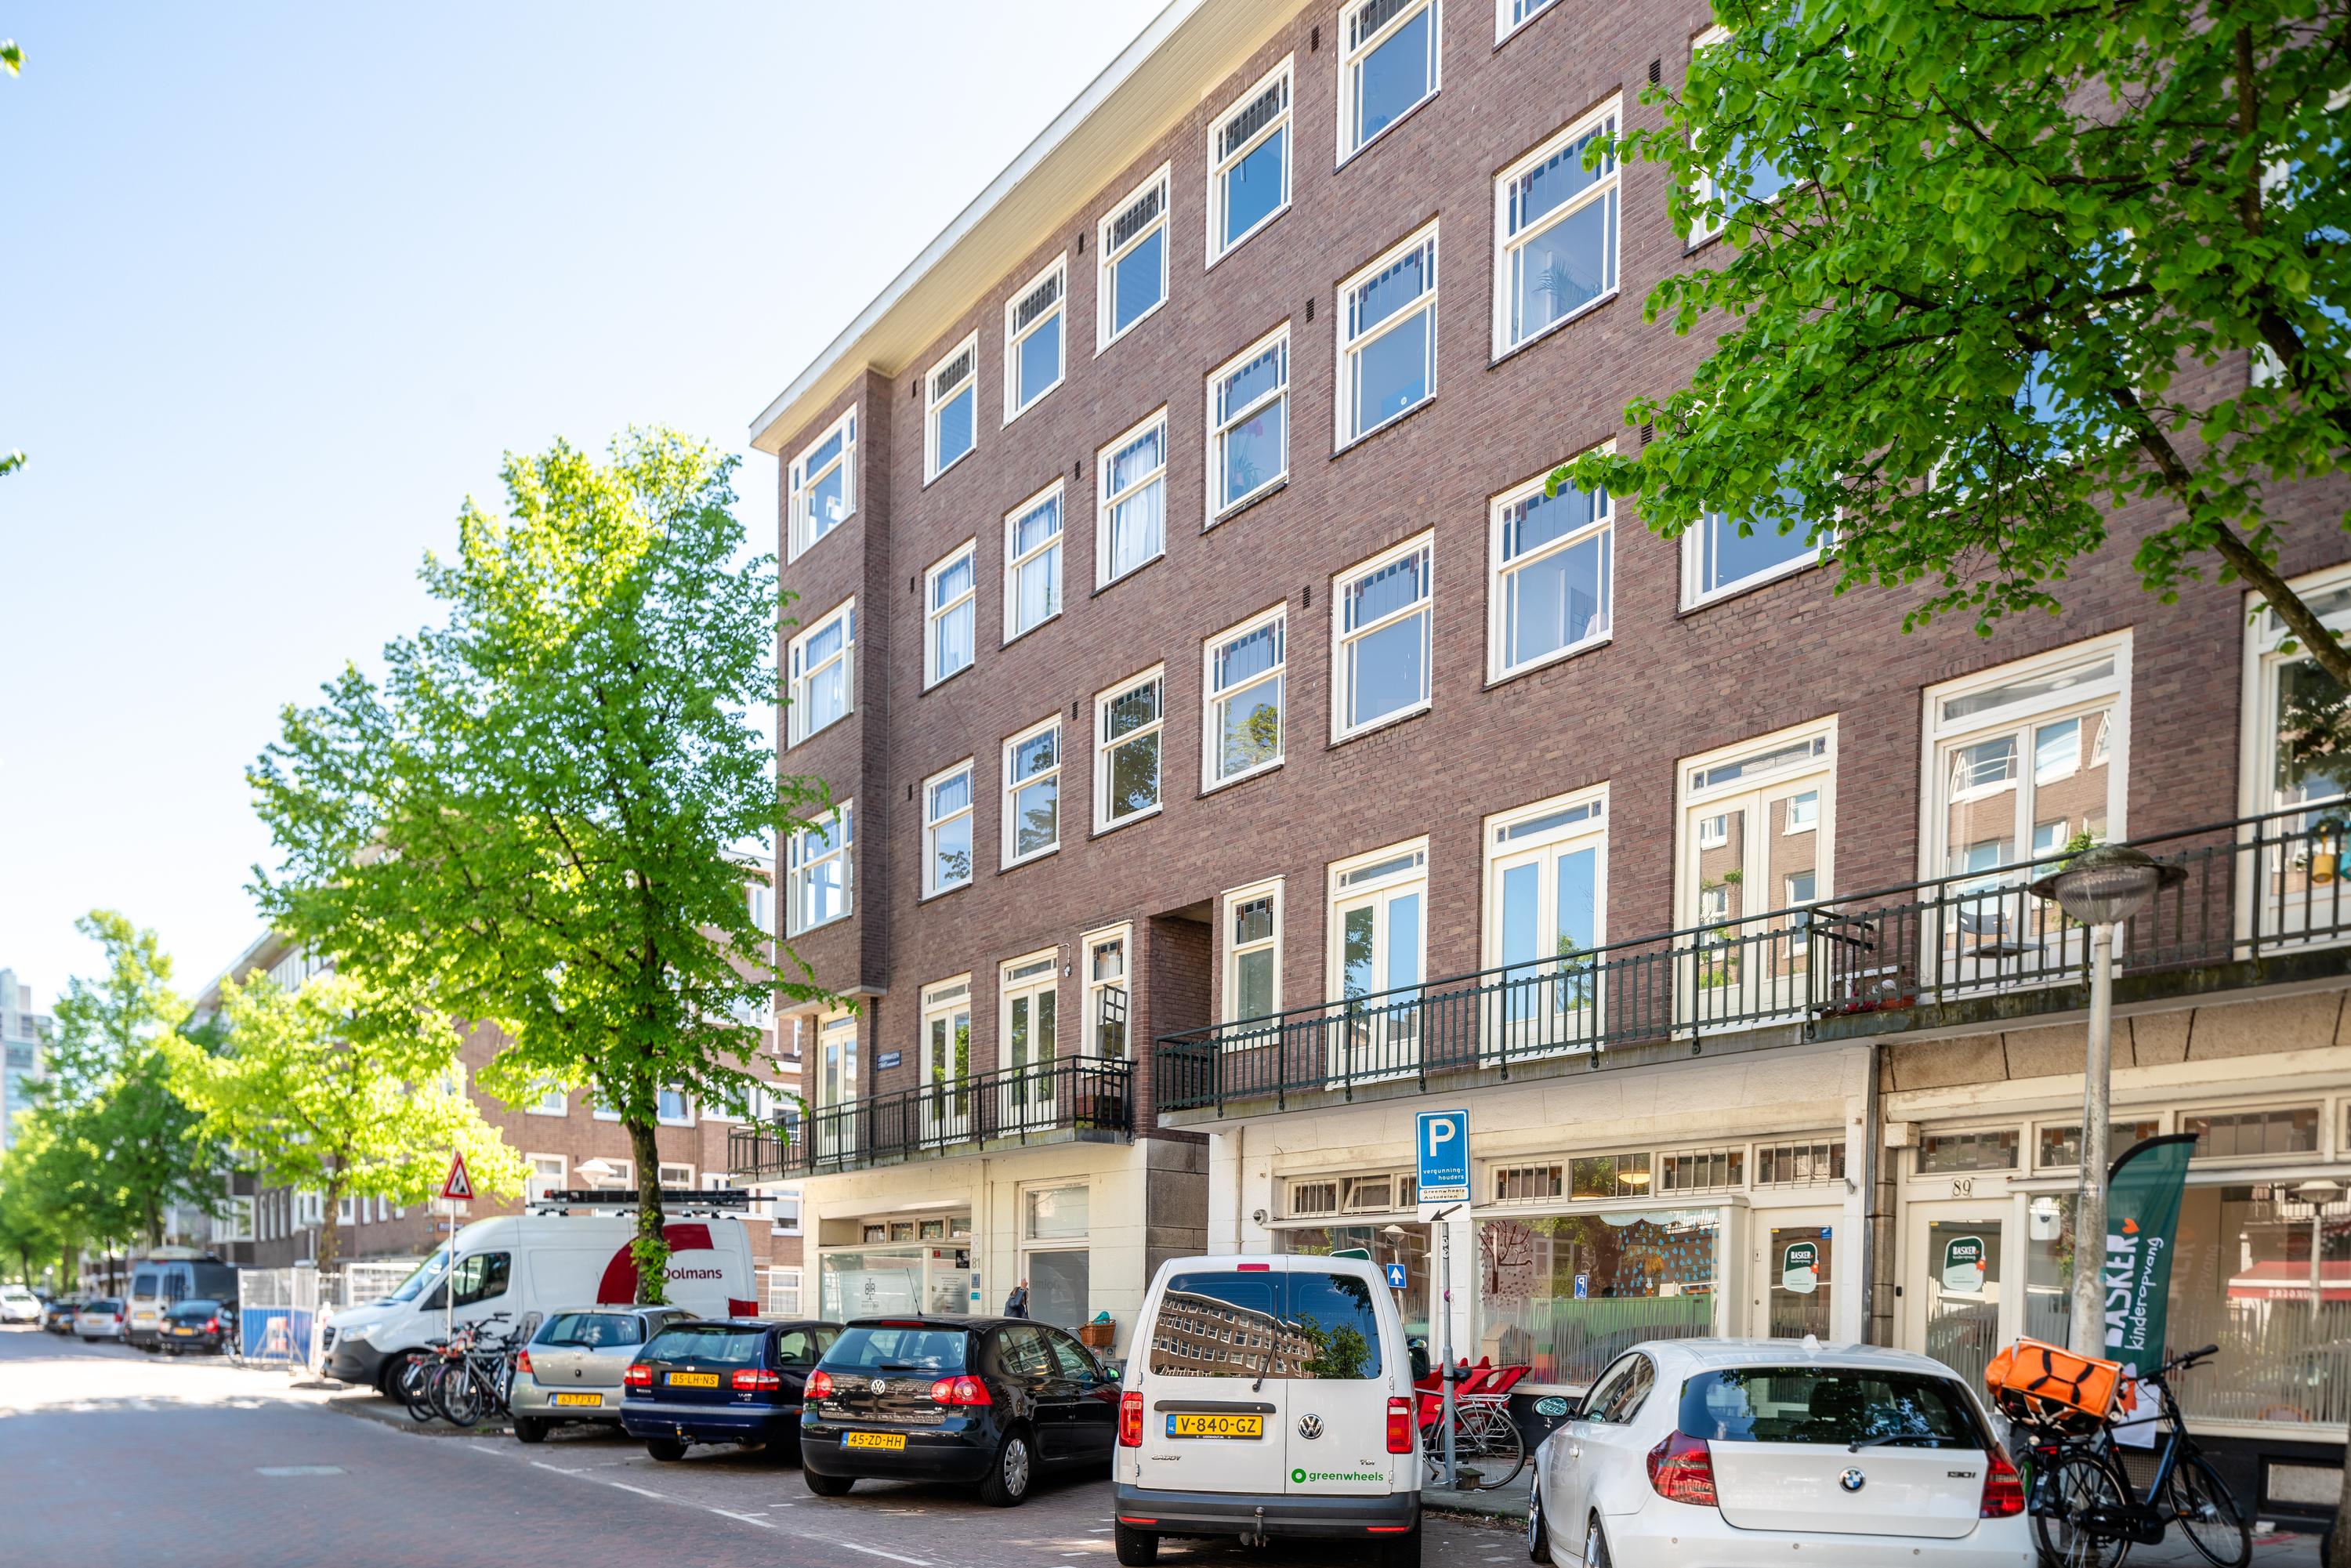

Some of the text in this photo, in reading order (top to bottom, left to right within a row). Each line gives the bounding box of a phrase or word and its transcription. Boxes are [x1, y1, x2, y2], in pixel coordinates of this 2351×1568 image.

[1429, 1118, 1456, 1157] P
[1952, 1179, 1972, 1197] 89
[1790, 1251, 1811, 1259] BASKER
[1952, 1246, 1976, 1255] BASKER
[972, 1257, 981, 1269] 81
[2124, 1237, 2164, 1351] kinderopvang
[672, 1374, 715, 1385] 85-LH-NS
[1180, 1417, 1256, 1433] V-840-GZ
[850, 1434, 903, 1447] 45-ZD-HH
[1309, 1471, 1384, 1482] greenwheels
